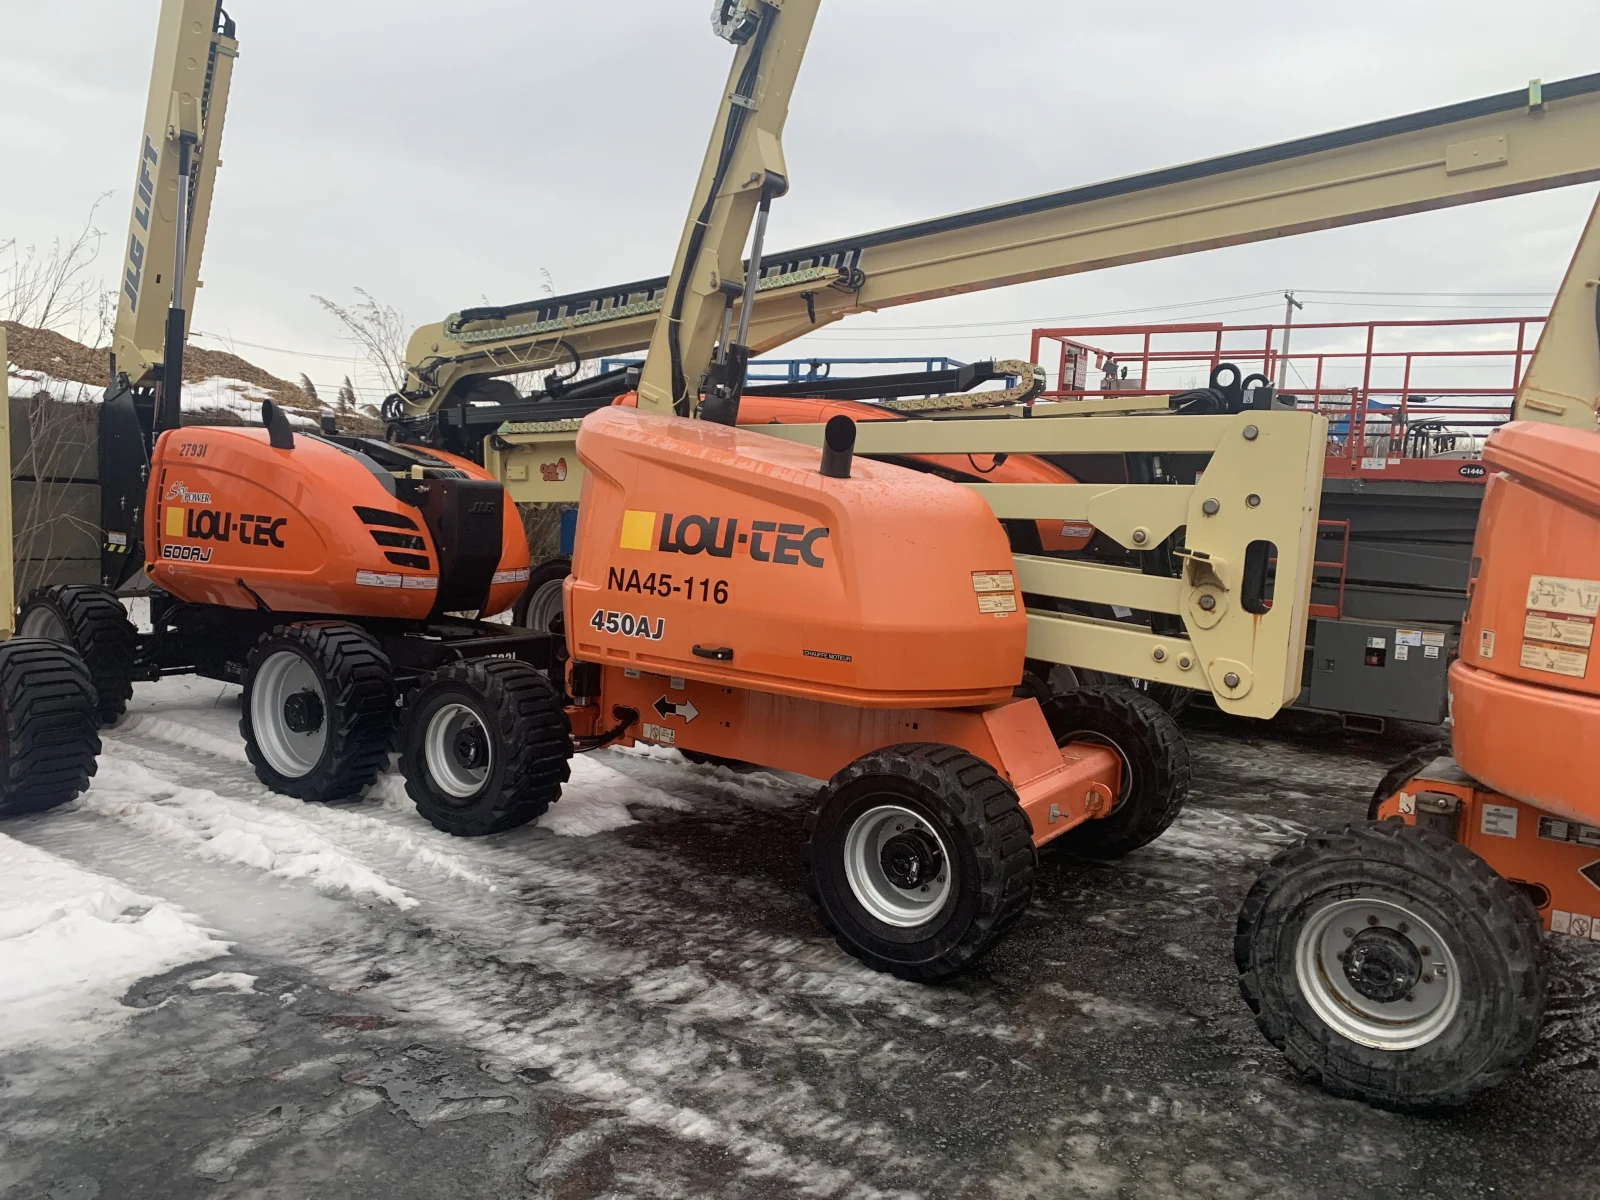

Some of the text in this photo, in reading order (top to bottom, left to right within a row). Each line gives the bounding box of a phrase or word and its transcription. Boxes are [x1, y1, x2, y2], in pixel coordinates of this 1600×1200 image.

[124, 134, 158, 314] JLG LIFT
[179, 443, 208, 458] 27931
[163, 544, 213, 563] 600AJ
[607, 567, 729, 605] NA45-116
[590, 608, 665, 641] 450AJ
